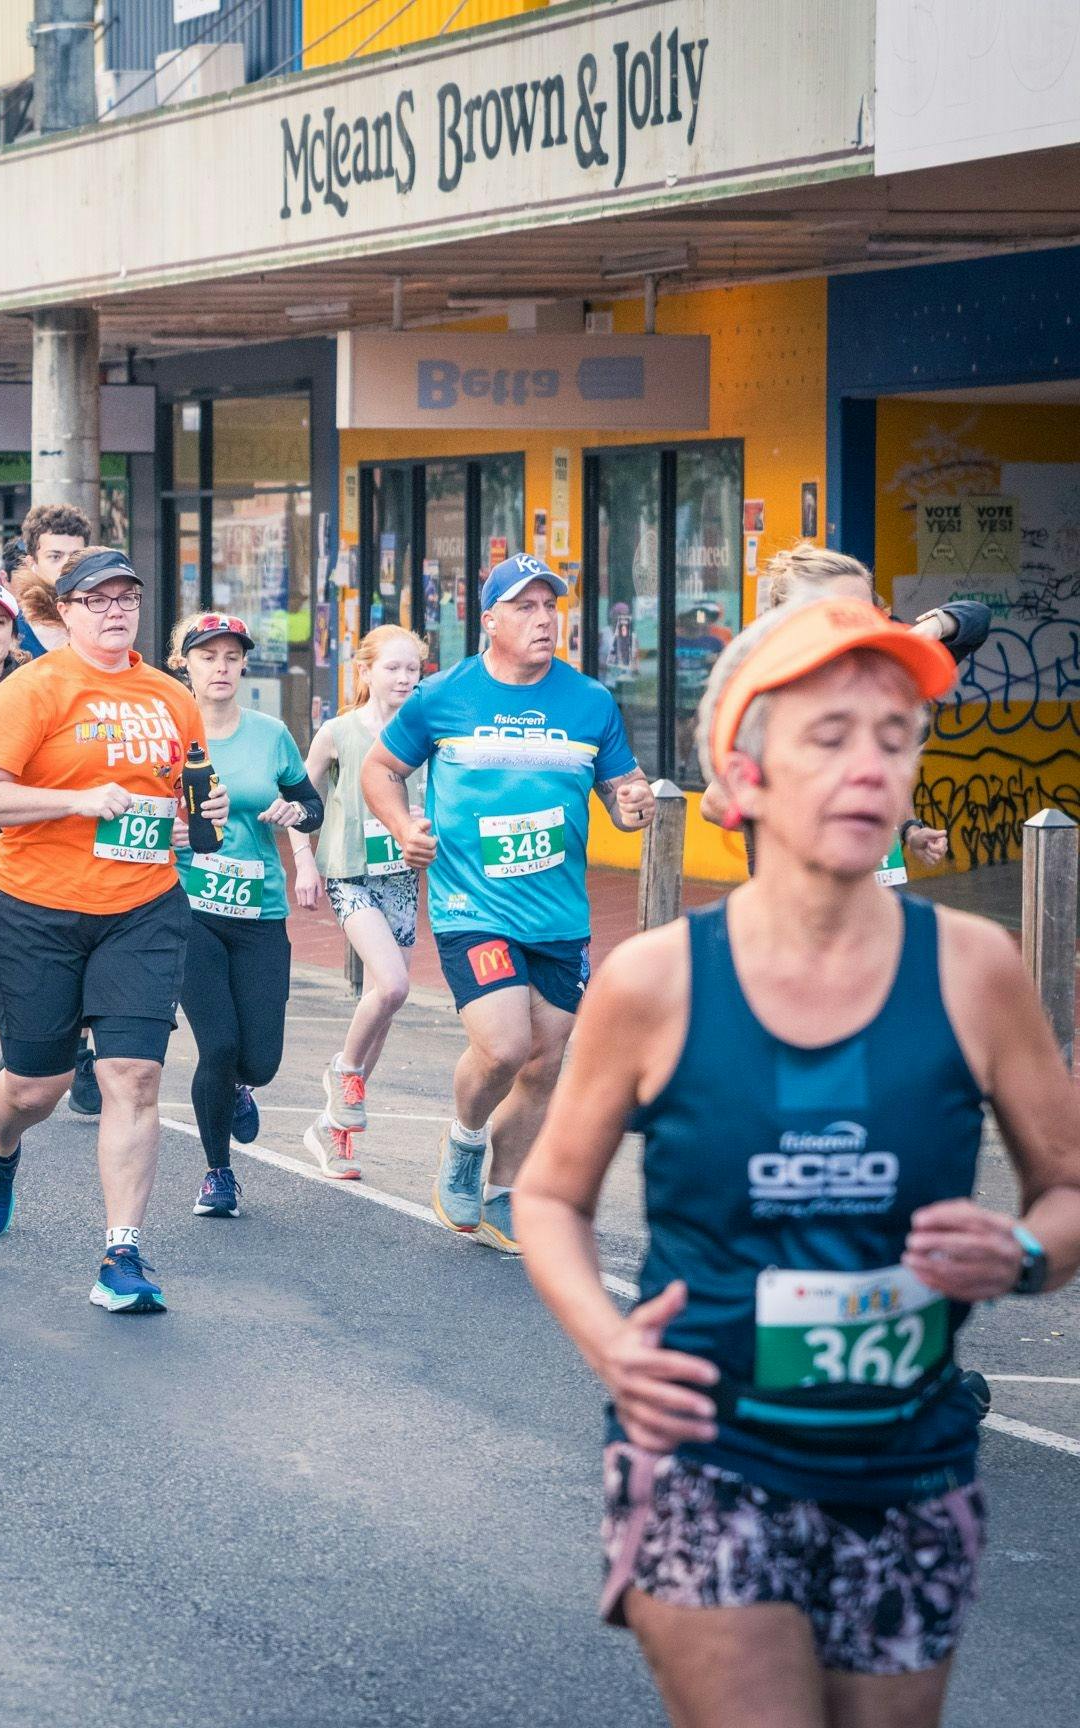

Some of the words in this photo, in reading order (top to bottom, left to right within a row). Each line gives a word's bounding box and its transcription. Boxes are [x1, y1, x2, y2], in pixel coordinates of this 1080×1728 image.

[436, 74, 568, 193] Brown
[574, 52, 610, 170] &
[612, 26, 709, 188] Jolly
[925, 505, 961, 518] VOTE
[977, 505, 1013, 518] VOTE
[926, 520, 961, 533] YES!
[978, 520, 1013, 533] YES!
[86, 698, 170, 721] WALK
[493, 713, 546, 725] fisiocrem
[121, 719, 179, 742] RUN
[119, 815, 160, 849] 196
[497, 830, 552, 865] 348
[200, 873, 252, 906] 346
[447, 910, 479, 918] COAST
[804, 1314, 925, 1389] 362
